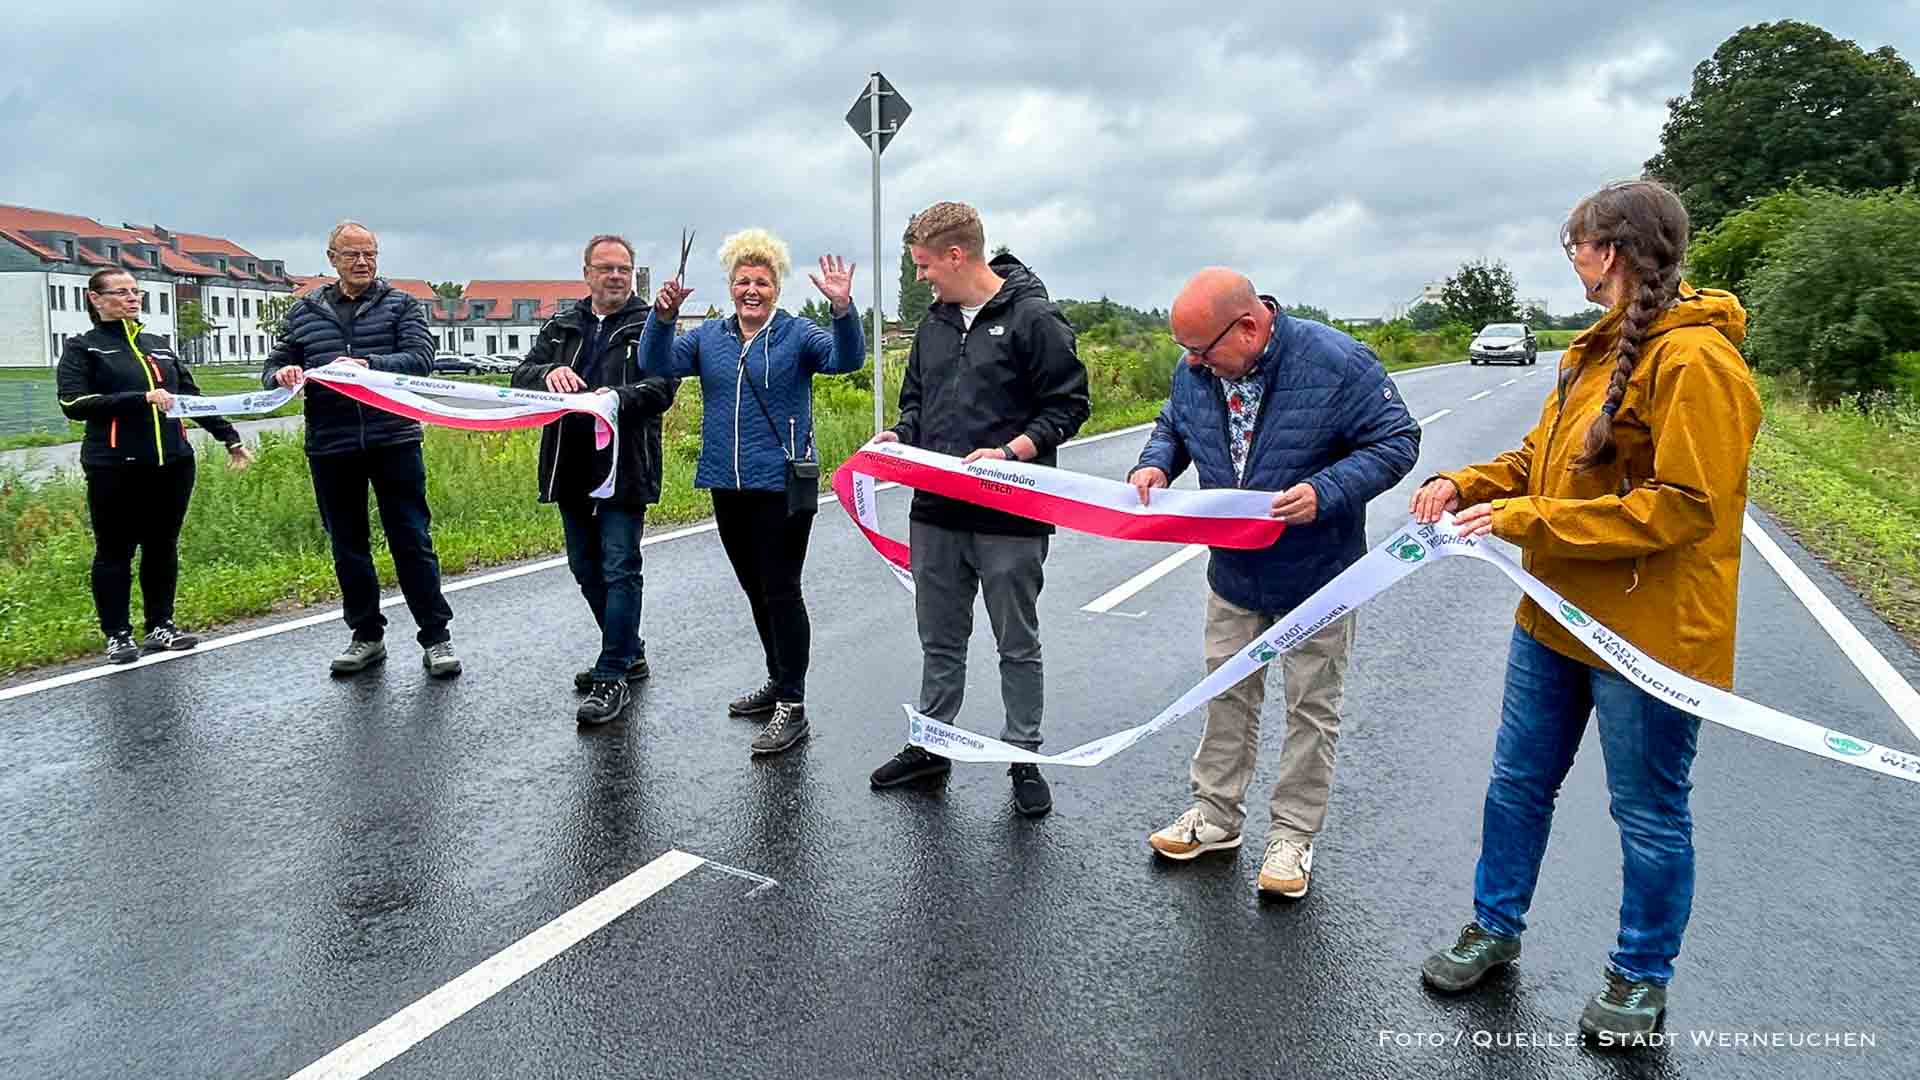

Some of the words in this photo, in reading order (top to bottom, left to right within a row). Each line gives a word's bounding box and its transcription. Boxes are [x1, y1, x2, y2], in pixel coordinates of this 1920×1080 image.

[966, 464, 1036, 487] Ingenieurbüro
[980, 479, 1013, 495] Hirsch
[1274, 622, 1305, 648] STADT
[1597, 626, 1640, 664] STADT
[1591, 630, 1701, 707] WERNEUCHEN
